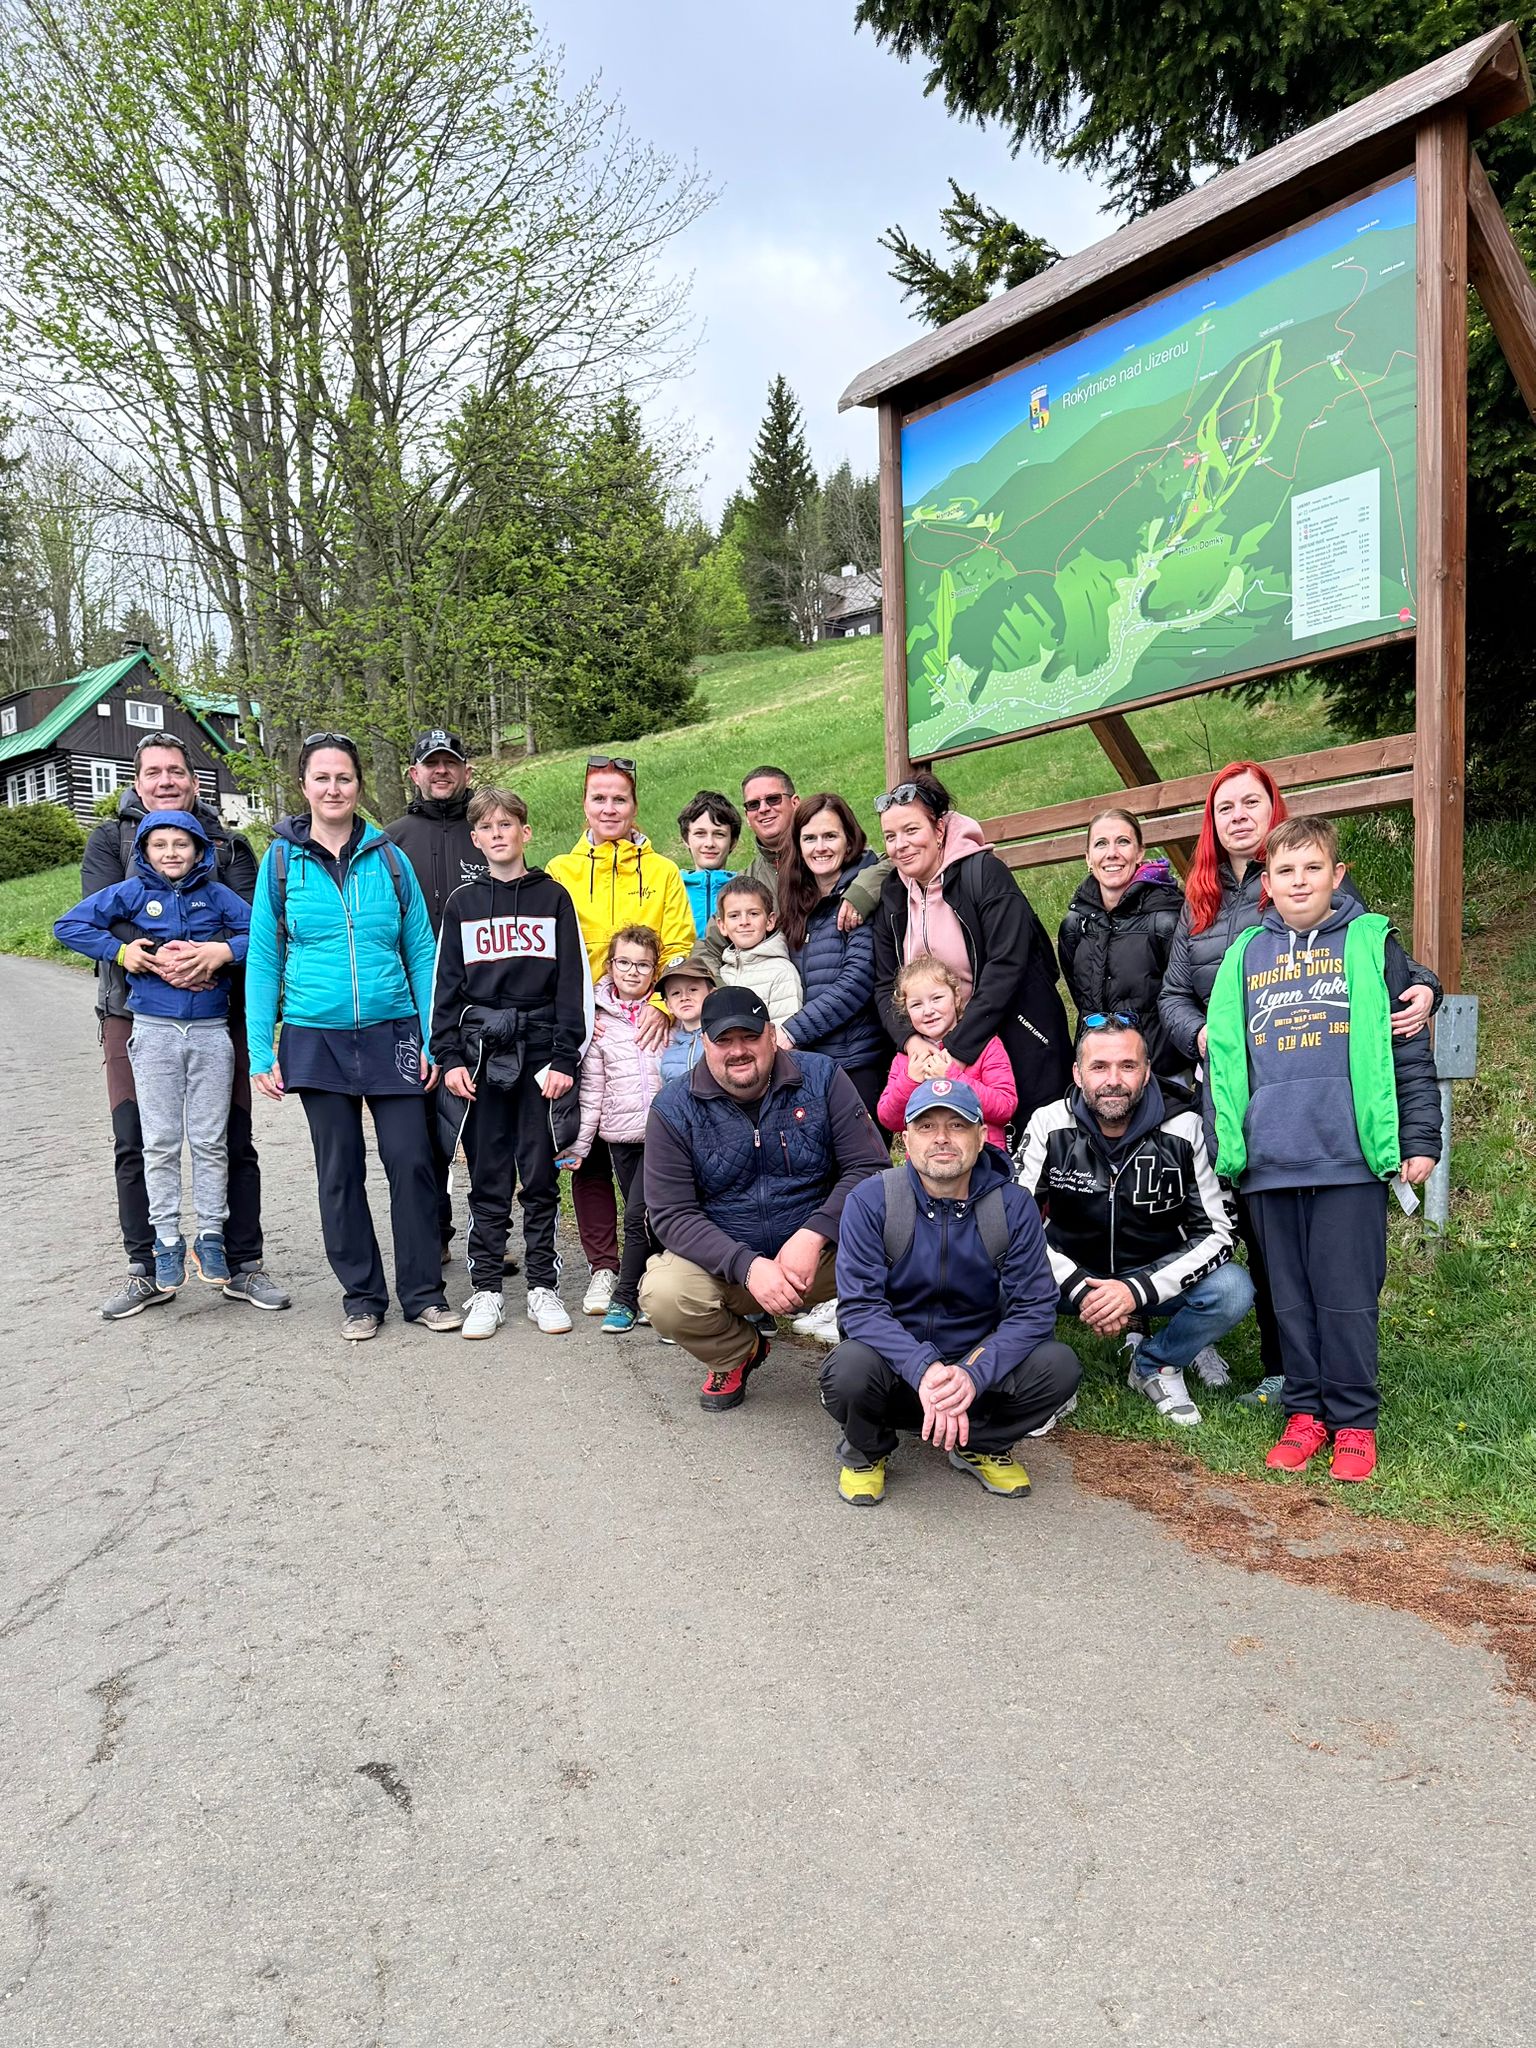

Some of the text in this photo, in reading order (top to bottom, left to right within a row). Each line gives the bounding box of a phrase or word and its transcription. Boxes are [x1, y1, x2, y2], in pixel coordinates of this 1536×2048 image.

[1062, 341, 1189, 409] Rokytnice nad Jizerou
[476, 923, 546, 955] GUESS
[1276, 947, 1330, 965] IRO KNGHTS
[1247, 957, 1345, 991] RUISING DIVIS
[1308, 976, 1349, 1000] Lake
[1277, 1031, 1322, 1052] 6TH AVE
[1133, 1155, 1186, 1214] LA
